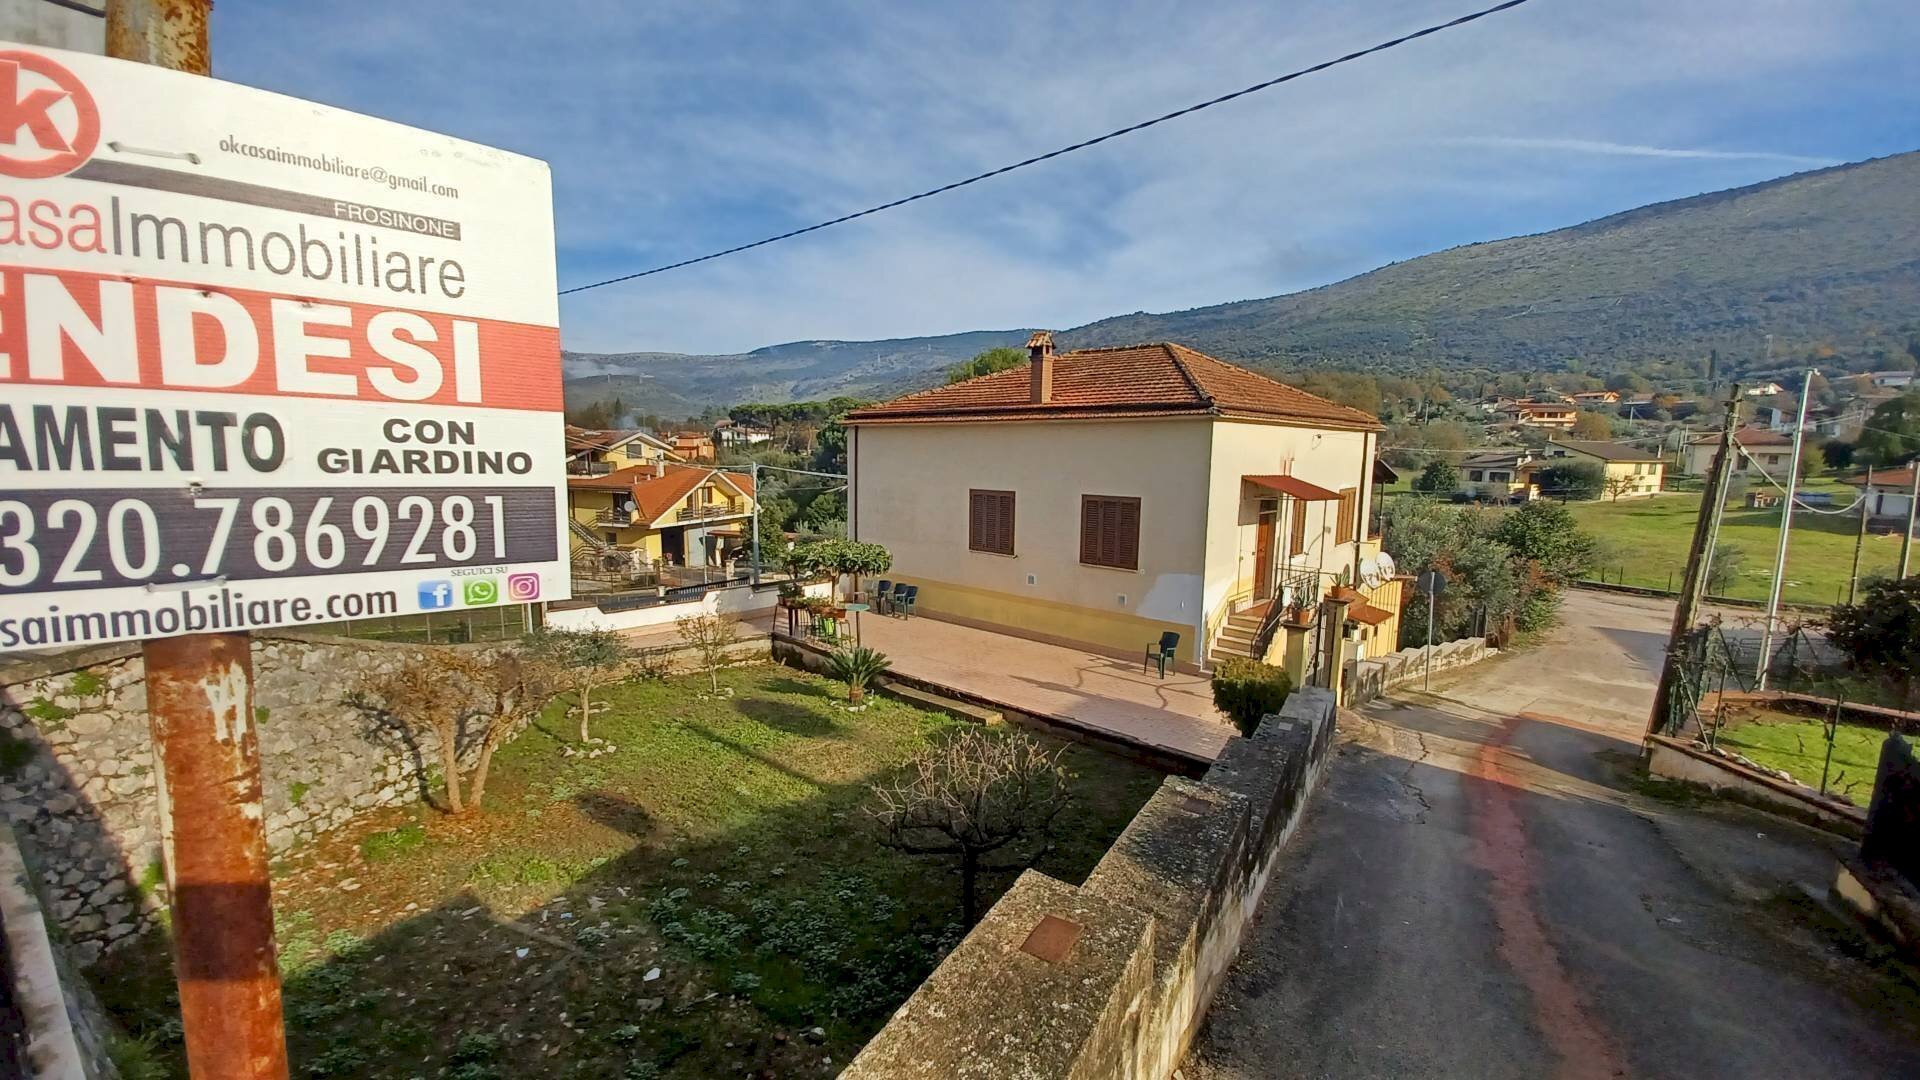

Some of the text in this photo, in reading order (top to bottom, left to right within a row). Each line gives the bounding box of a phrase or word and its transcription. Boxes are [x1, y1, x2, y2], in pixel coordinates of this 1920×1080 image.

[219, 135, 459, 199] okcasaimmobiliare@gmail.com
[333, 200, 455, 238] FROSINONE
[0, 272, 482, 404] NDESI
[383, 418, 475, 445] CON
[317, 448, 533, 475] GIARDINO
[0, 495, 507, 587] 320.7869281
[451, 566, 508, 577] SEGUICI SU
